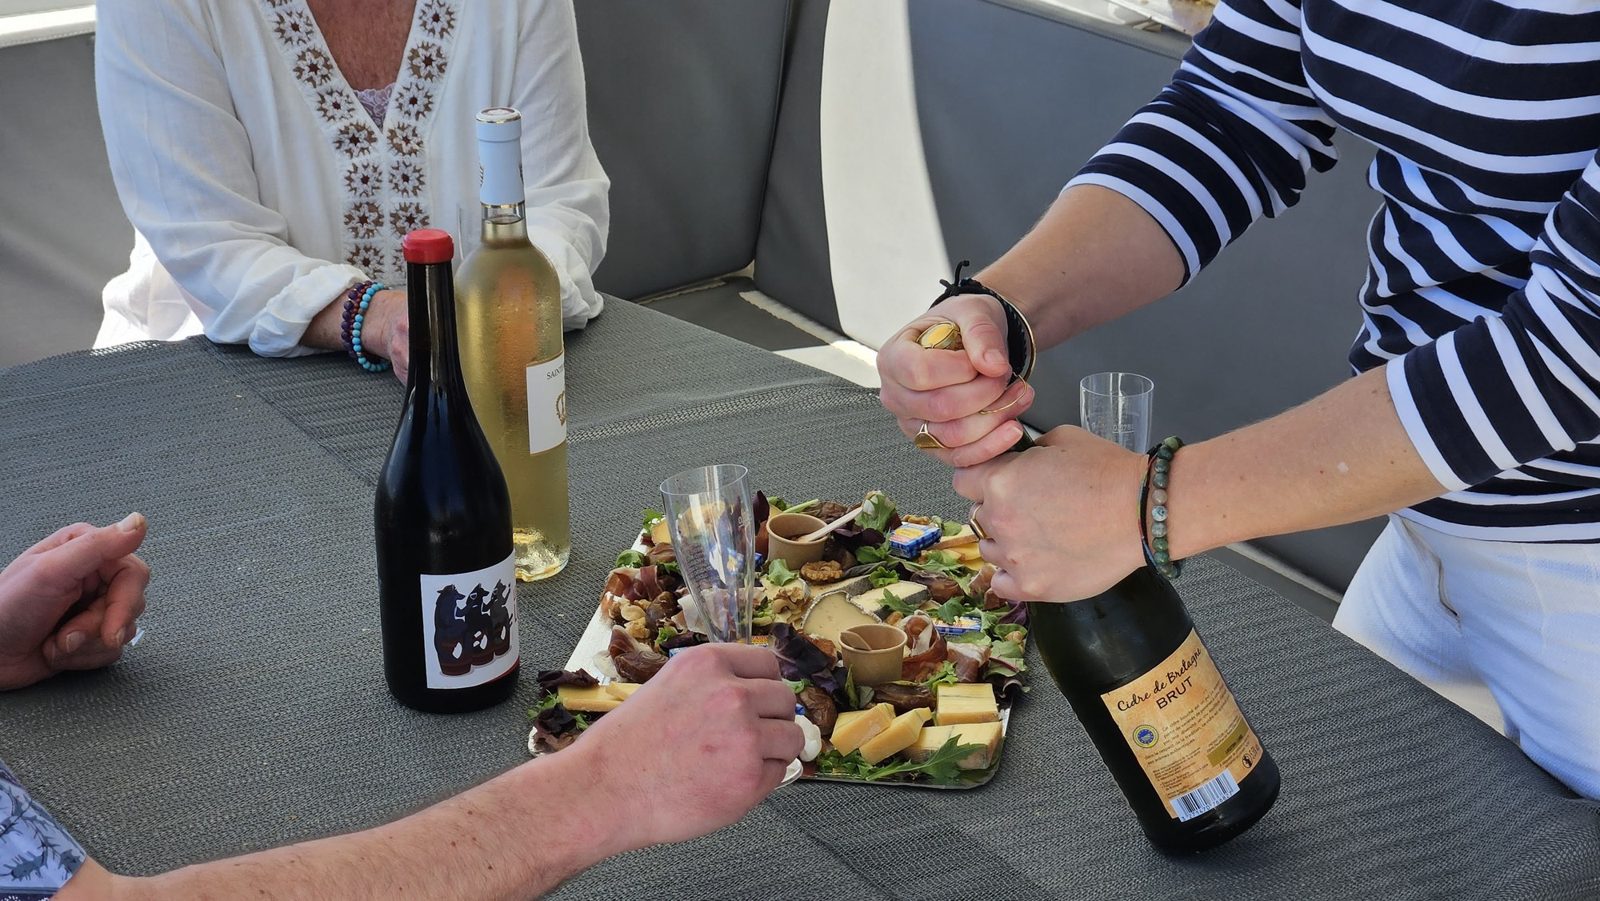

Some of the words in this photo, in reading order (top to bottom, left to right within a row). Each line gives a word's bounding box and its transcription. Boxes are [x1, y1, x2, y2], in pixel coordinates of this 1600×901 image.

[1117, 692, 1151, 712] Cidre
[1153, 680, 1168, 694] de
[1166, 648, 1201, 684] Bretagne
[1156, 676, 1192, 709] BRUT
